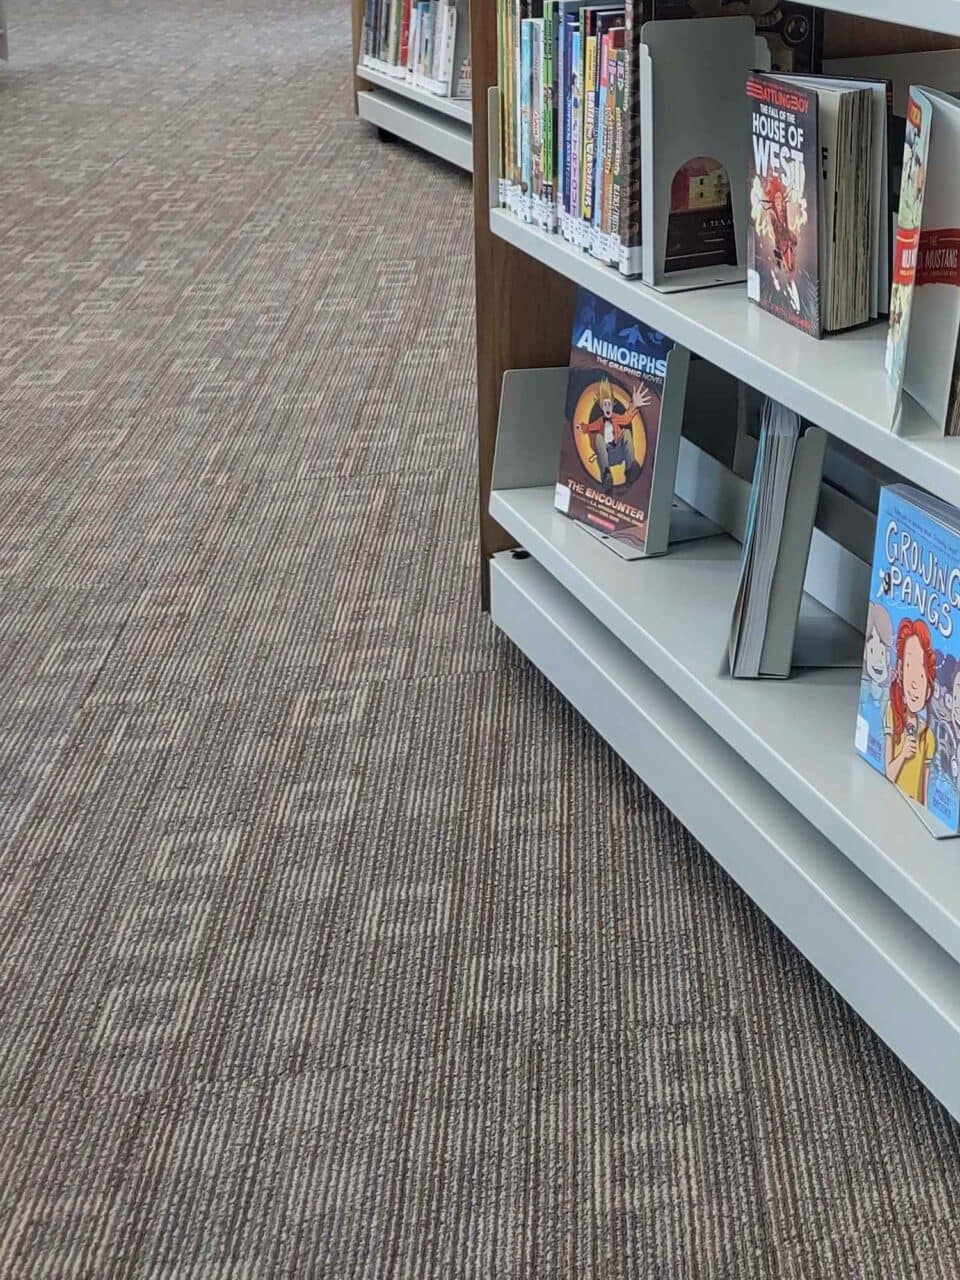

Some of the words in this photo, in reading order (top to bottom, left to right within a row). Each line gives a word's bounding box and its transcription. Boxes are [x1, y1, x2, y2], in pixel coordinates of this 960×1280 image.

[752, 112, 786, 144] HOUSE
[788, 125, 804, 149] OF
[760, 103, 769, 114] THE
[768, 106, 779, 119] FALL
[779, 109, 787, 121] OF
[786, 112, 796, 124] THE
[752, 134, 804, 190] WEST
[925, 248, 958, 269] MUSTANG
[576, 328, 667, 378] ANIMORPHS
[596, 356, 609, 366] THE
[608, 360, 642, 378] GRAPHIC
[642, 372, 663, 385] NOVEL
[567, 479, 585, 494] THE
[585, 487, 645, 521] ENCOUNTER
[890, 565, 953, 638] PANGS
